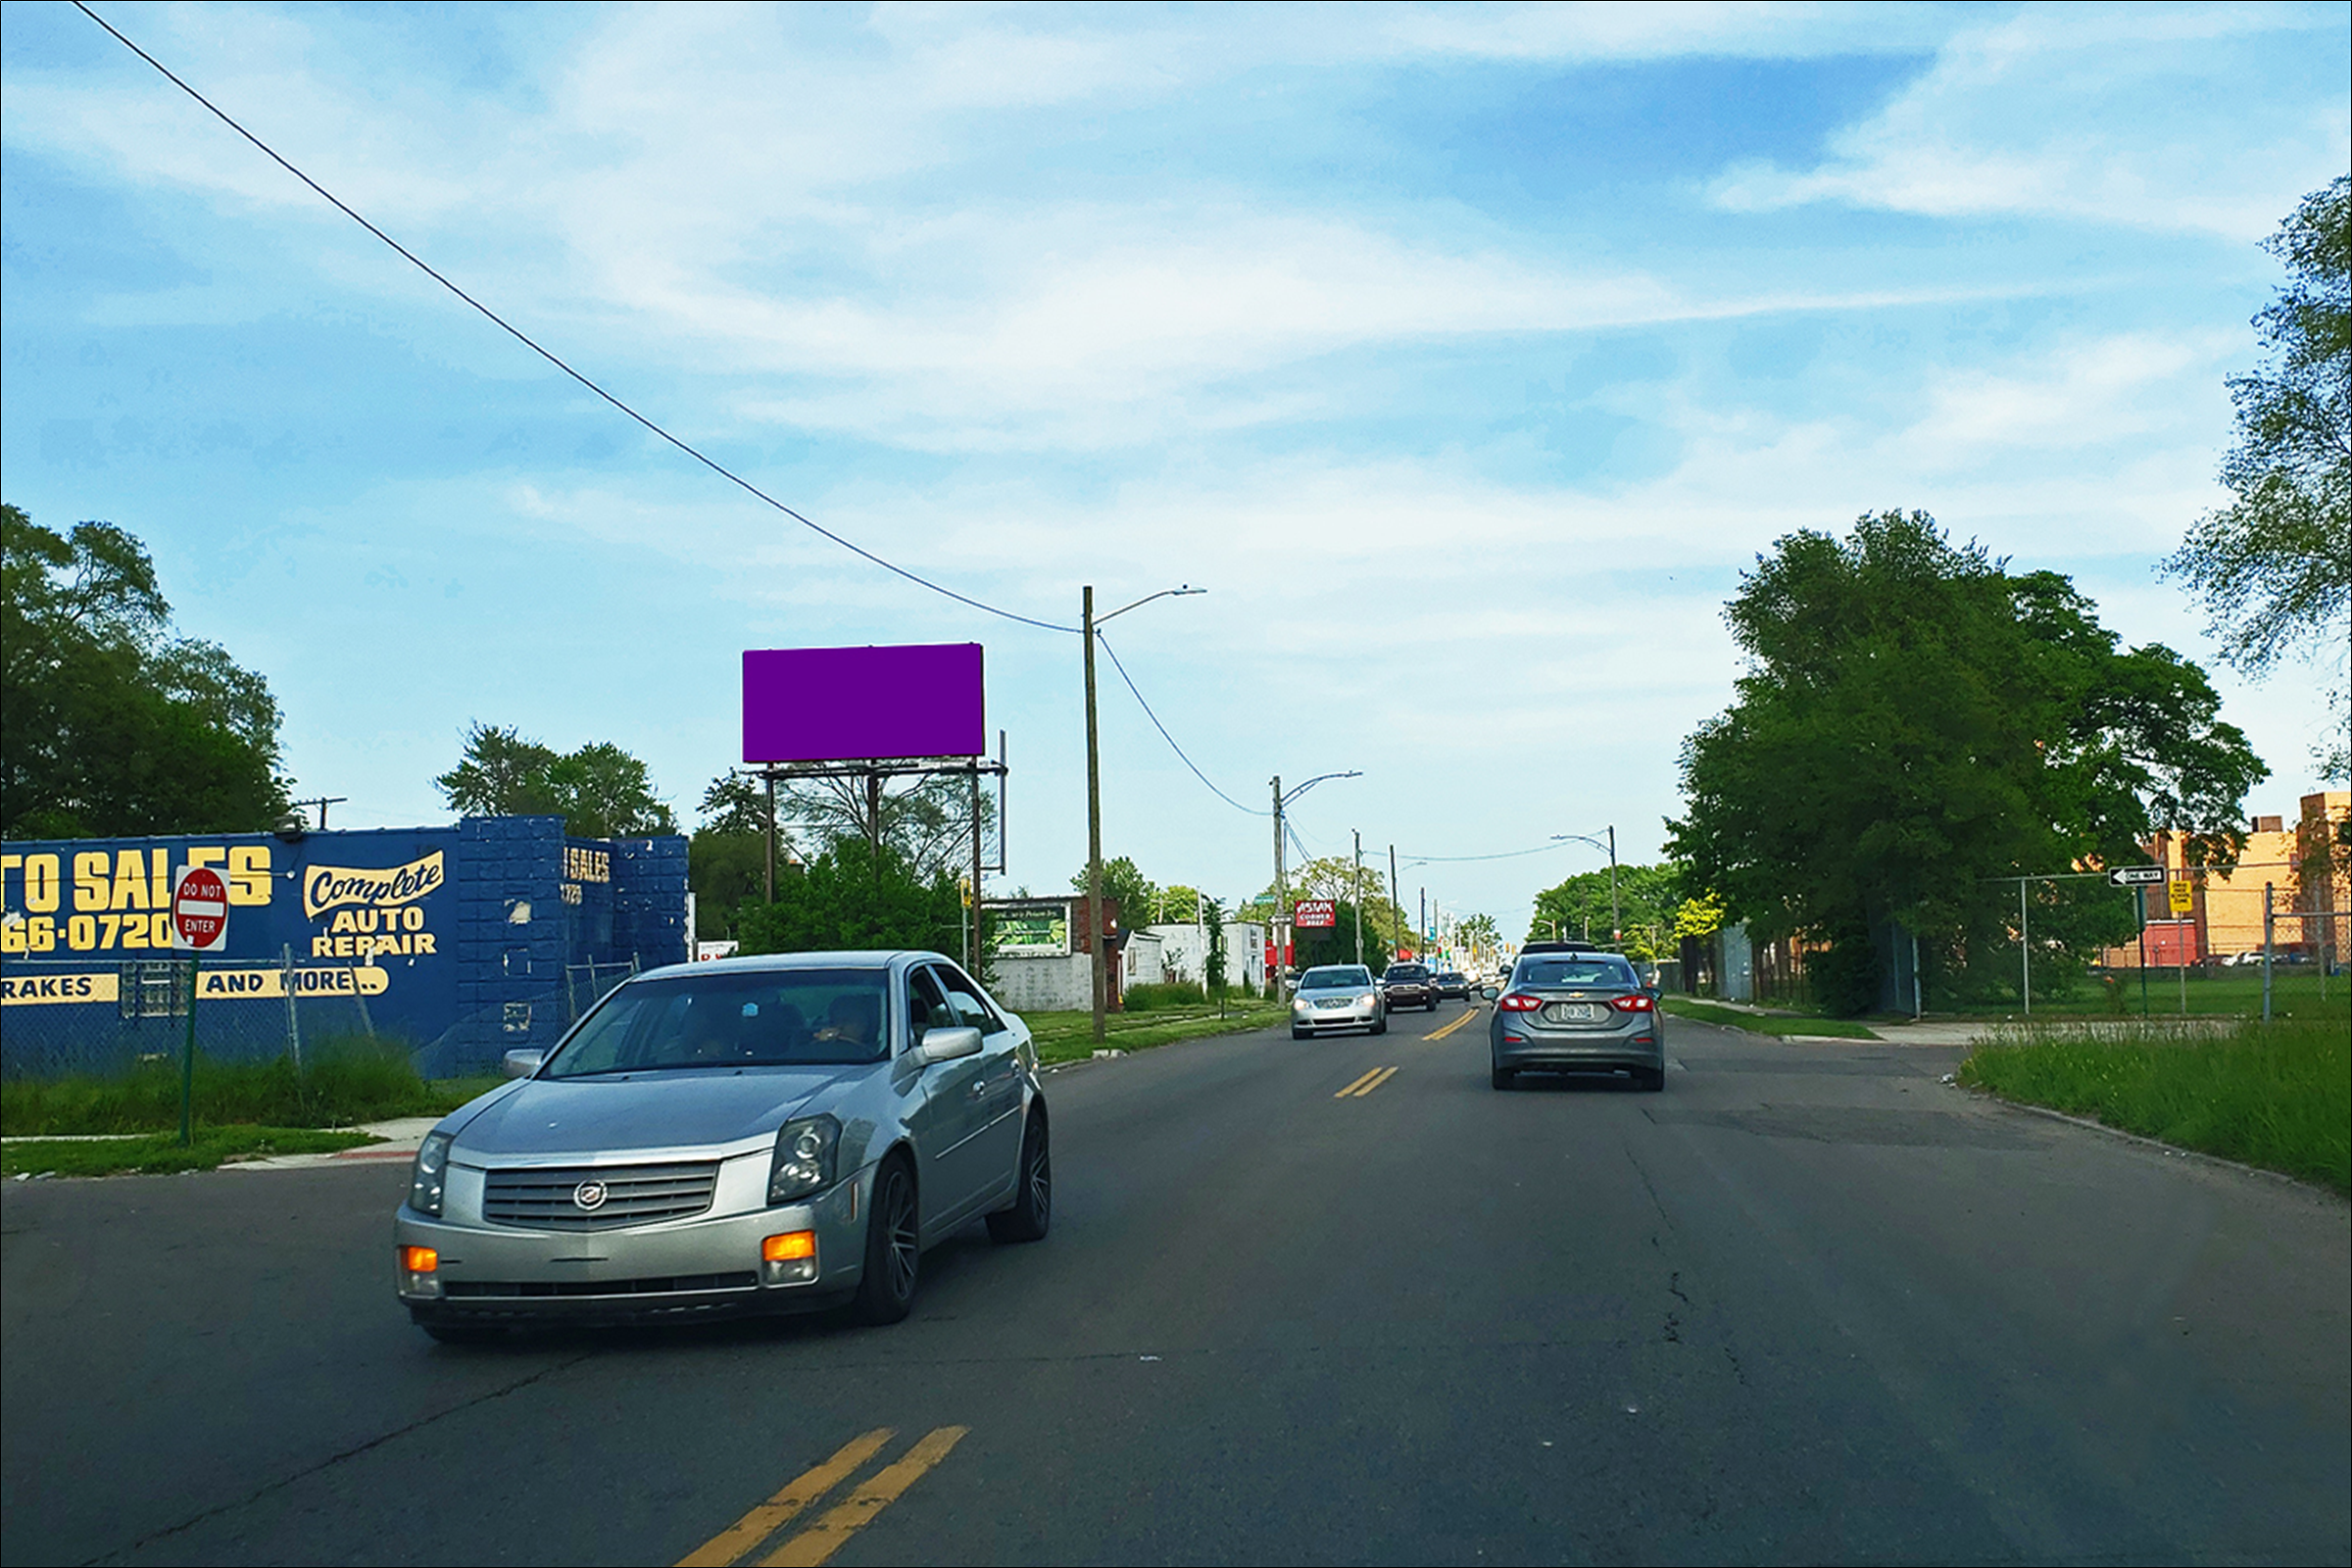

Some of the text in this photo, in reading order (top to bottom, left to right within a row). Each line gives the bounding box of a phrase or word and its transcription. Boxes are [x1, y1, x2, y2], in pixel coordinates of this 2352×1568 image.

[569, 848, 610, 883] SALES
[2142, 871, 2159, 880] WAY
[183, 883, 221, 898] DO NOT
[311, 863, 442, 909] Complete
[1297, 902, 1333, 913] ASIAN
[184, 918, 216, 933] ENTER
[331, 906, 424, 933] AUTO
[312, 933, 437, 958] REPAIR
[1, 977, 92, 999] RAKES
[206, 974, 264, 993] AND
